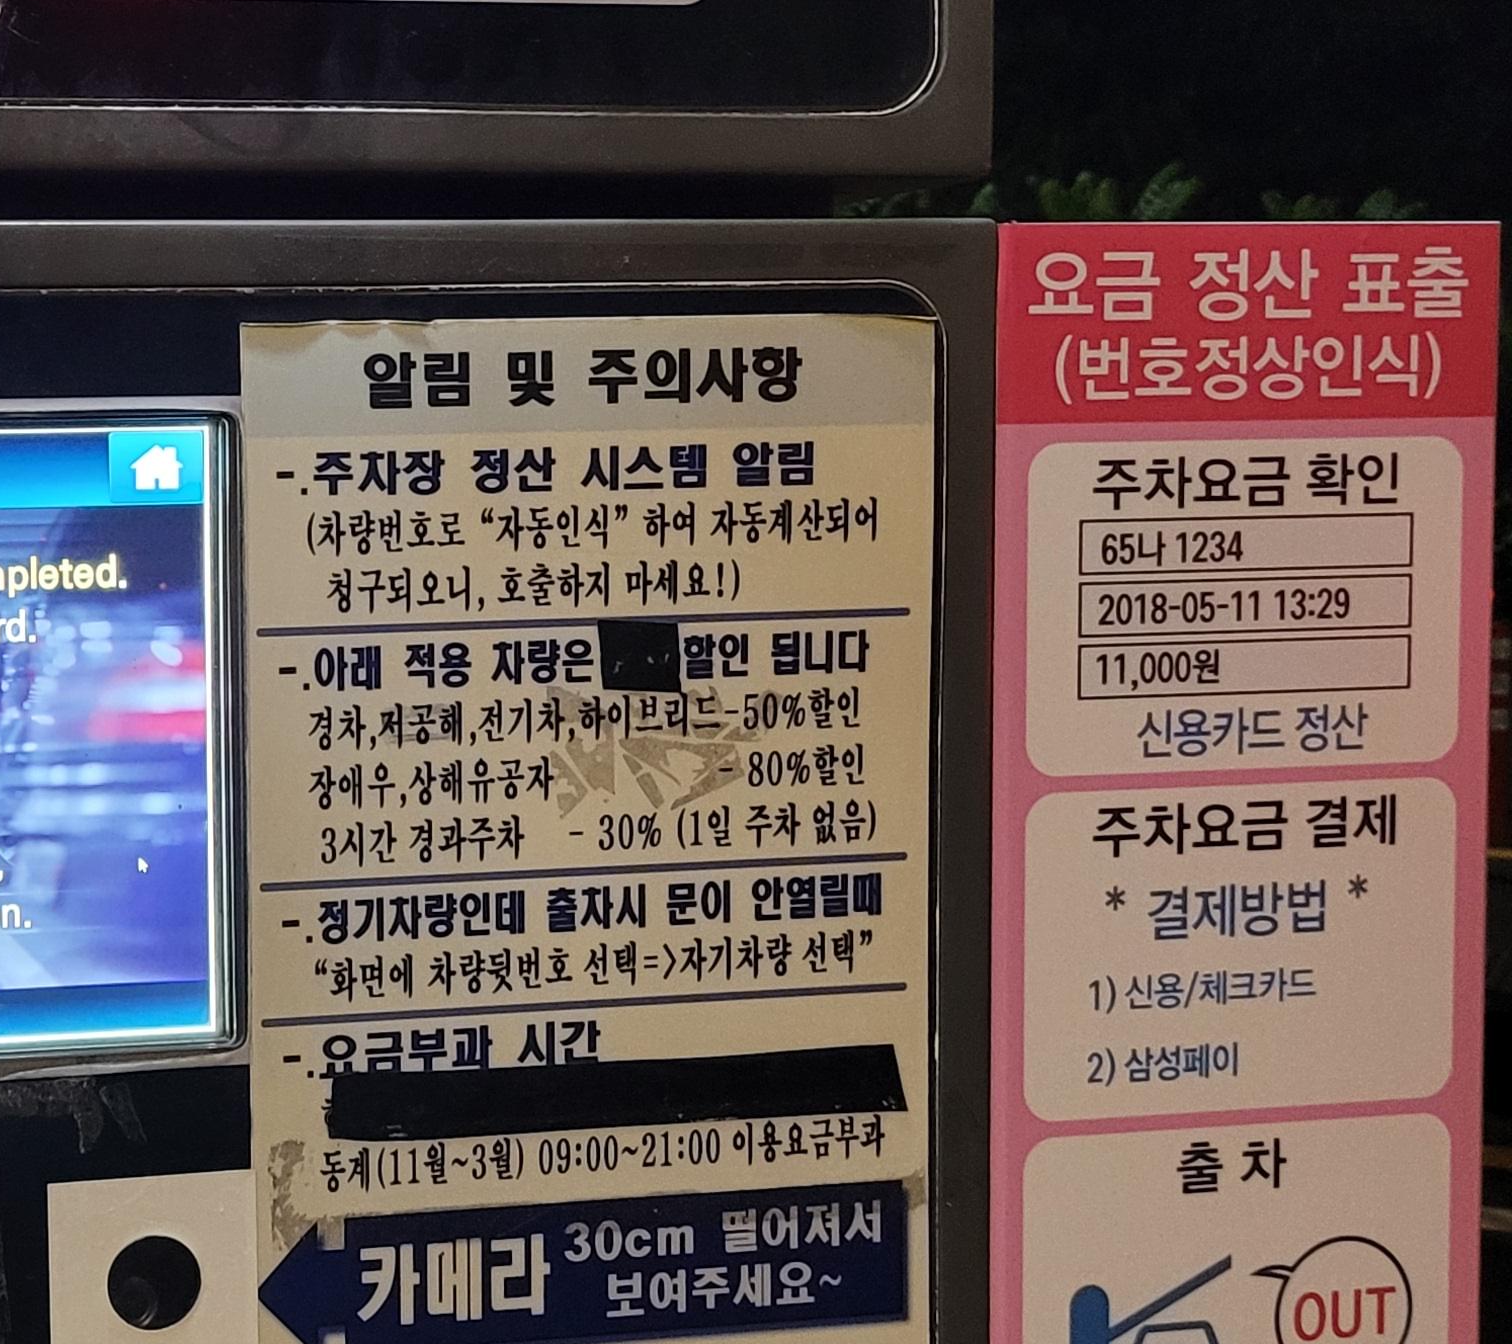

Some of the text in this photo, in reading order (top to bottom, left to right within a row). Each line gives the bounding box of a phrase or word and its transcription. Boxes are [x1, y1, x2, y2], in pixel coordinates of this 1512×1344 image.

[1028, 246, 1469, 321] 요금 정산 표출
[364, 346, 802, 409] 알림 및 주의사항
[1055, 331, 1441, 405] (번호정상인식)
[471, 442, 815, 493] 정산 시스템 알림
[1093, 452, 1399, 510] 주차요금 확인
[645, 503, 696, 547] 하여
[711, 497, 878, 544] 자동계산되어
[1101, 530, 1244, 567] 65나 1234
[497, 562, 610, 607] 호출하지
[1098, 588, 1350, 626] 2018-05-11 13:29
[405, 629, 869, 688] 적용 차량은 할인 됩니다
[1096, 649, 1220, 690] 11,000원
[1137, 703, 1368, 758] 신용카드 정산
[321, 805, 801, 867] 3시간 경과주차 30% 주차
[1092, 793, 1397, 858] 주차요금 결제
[546, 872, 882, 933] 출차시 문이 안열릴때
[1147, 880, 1327, 940] 결제방법
[1124, 968, 1316, 1010] 신용/체크카드
[1124, 1042, 1239, 1082] 삼성페이
[731, 1114, 885, 1165] 이용요금부과
[357, 1199, 882, 1326] 카메라 30cm 떨어져서
[1294, 1287, 1396, 1341] OUT
